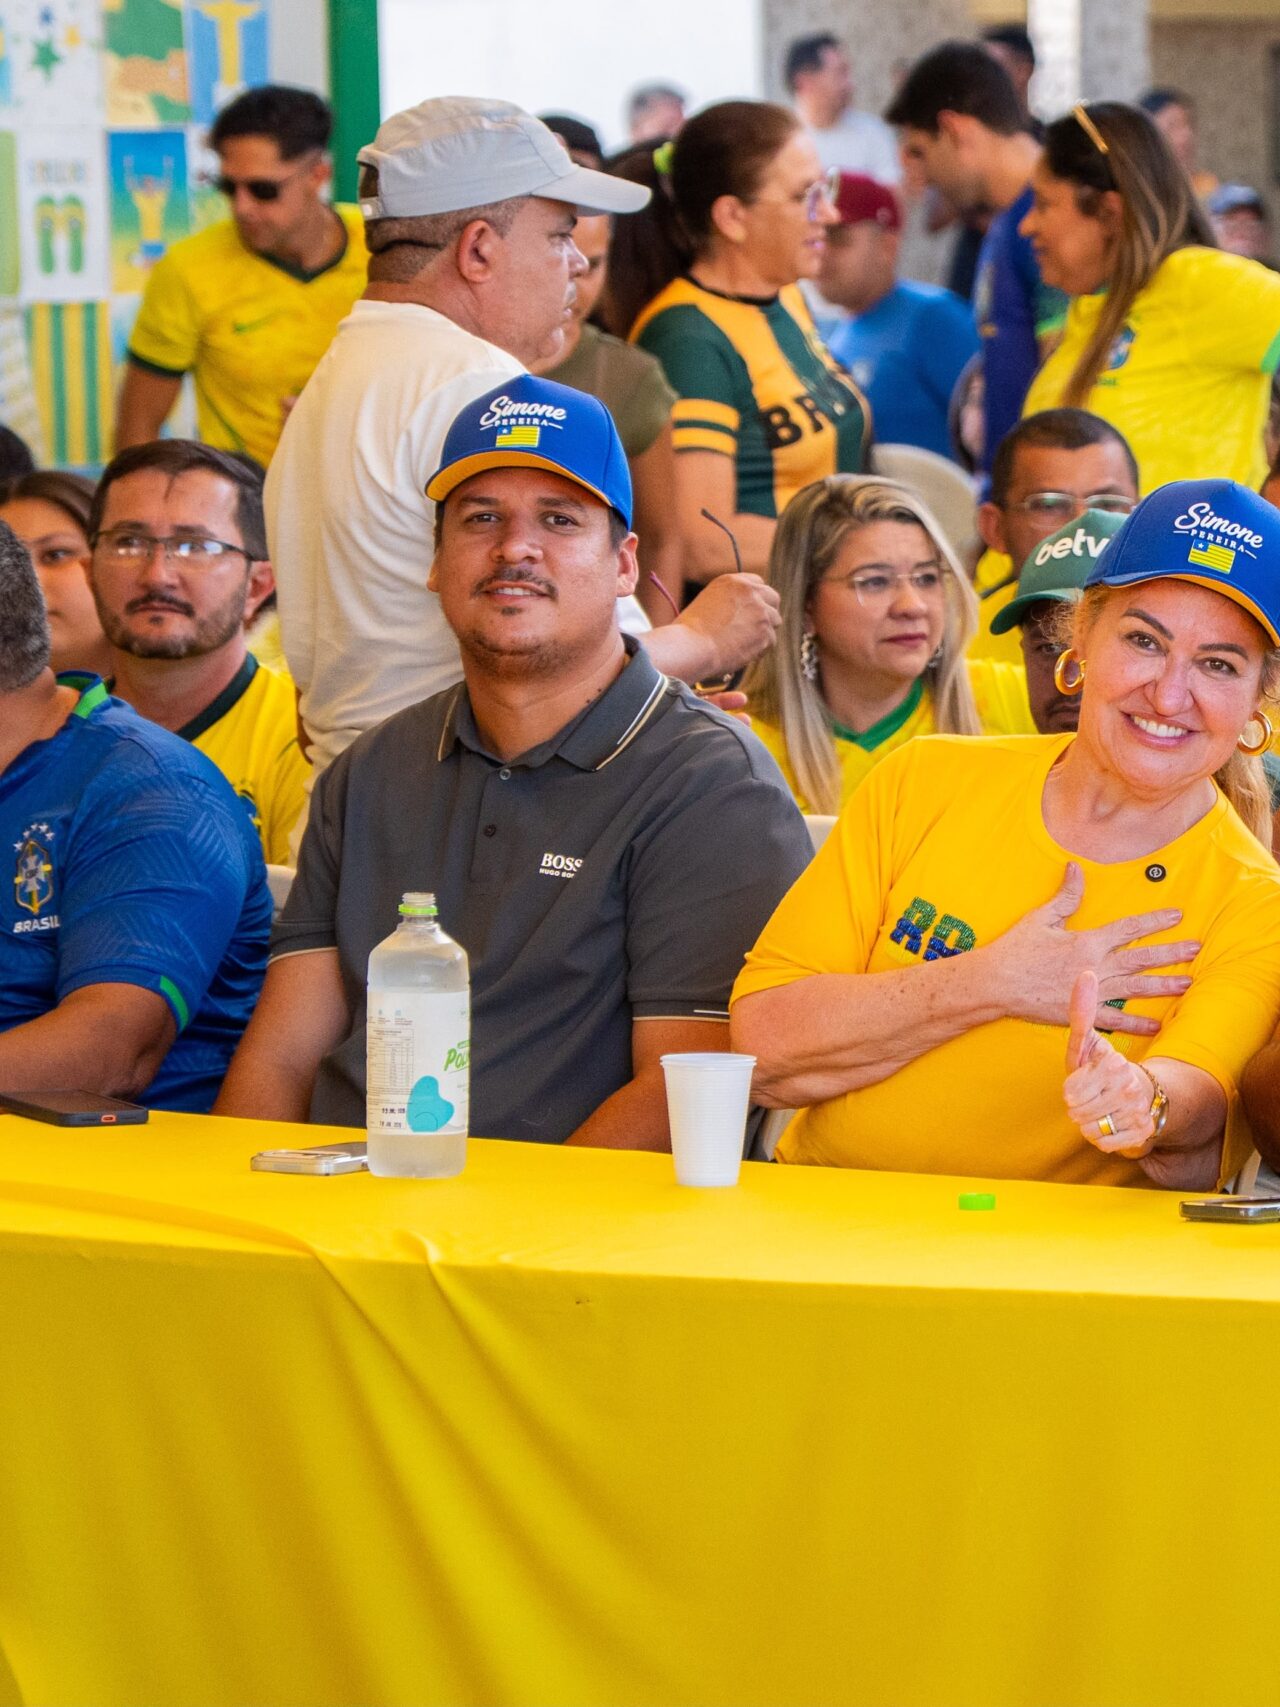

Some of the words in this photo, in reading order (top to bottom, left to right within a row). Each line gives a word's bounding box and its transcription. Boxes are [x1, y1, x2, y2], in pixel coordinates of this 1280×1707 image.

[480, 395, 566, 426] Simone
[494, 417, 549, 427] PEREIRA
[1174, 502, 1263, 548] Simone
[1190, 529, 1245, 553] PEREIRA
[13, 915, 60, 933] BRASIL
